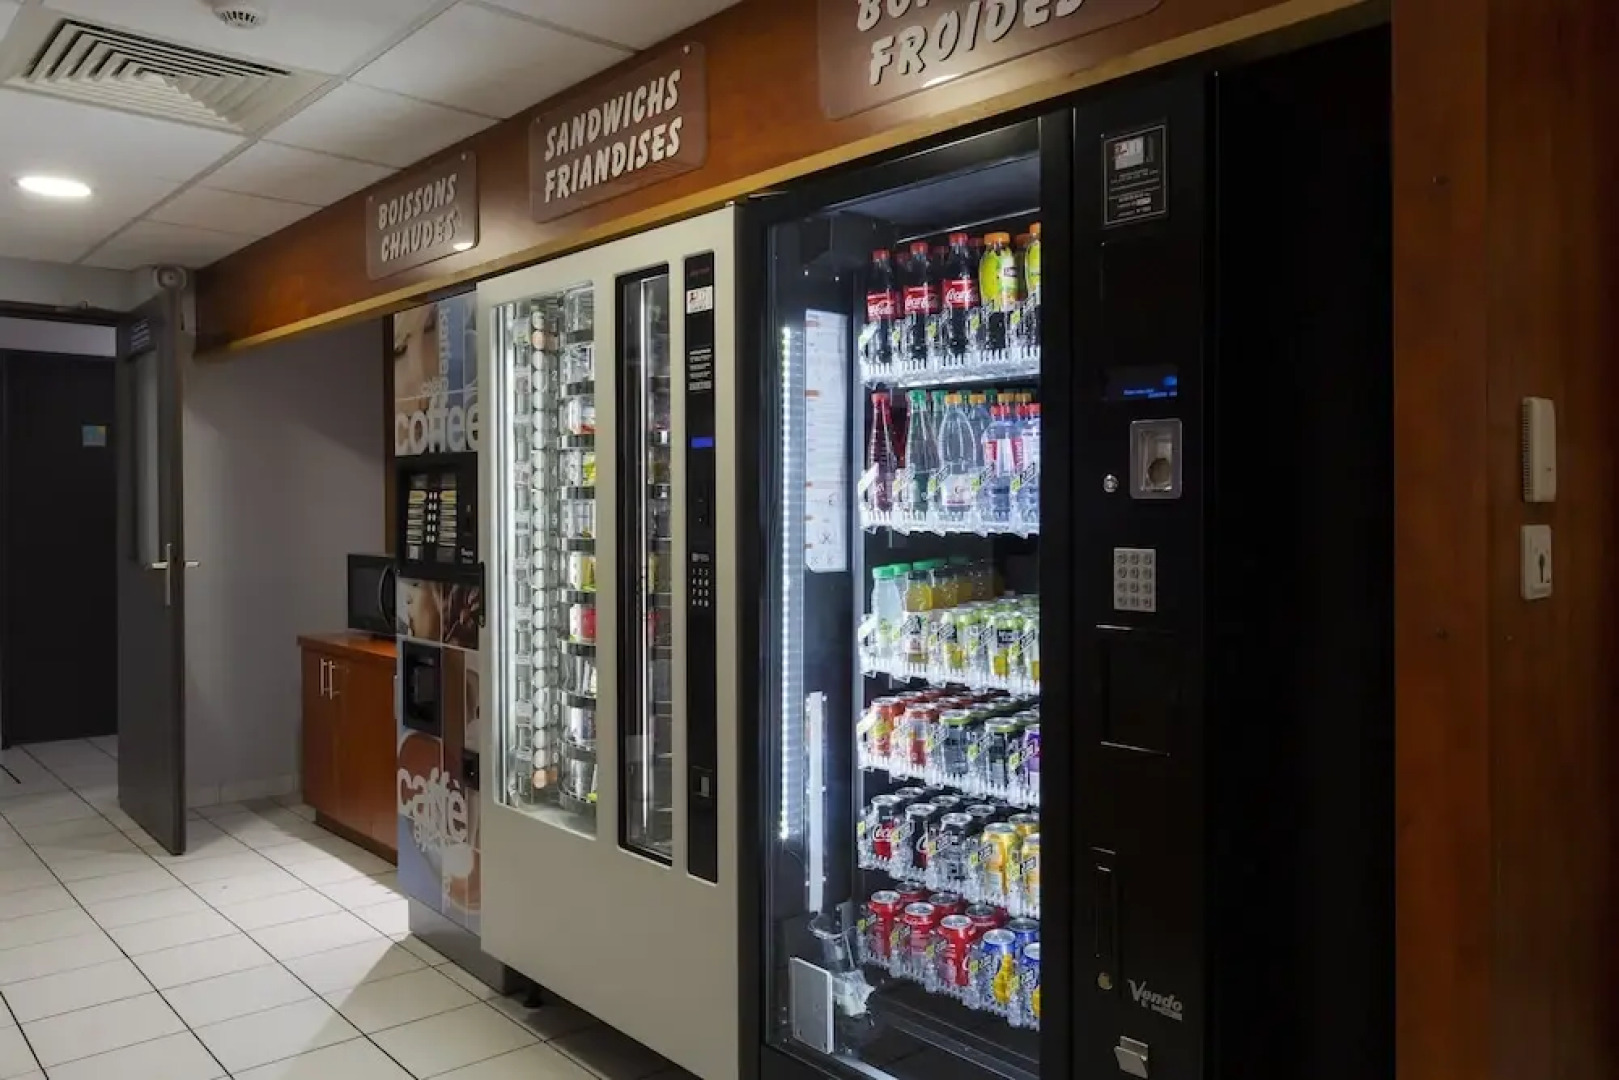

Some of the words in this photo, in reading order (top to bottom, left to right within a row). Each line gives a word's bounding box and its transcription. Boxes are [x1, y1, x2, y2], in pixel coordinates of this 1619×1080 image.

[544, 69, 682, 162] SANDWICHS
[544, 116, 684, 203] FRIANDISES
[379, 173, 457, 231] BOISSONS
[381, 207, 456, 262] CHAUDES
[1127, 979, 1183, 1011] Vendo
